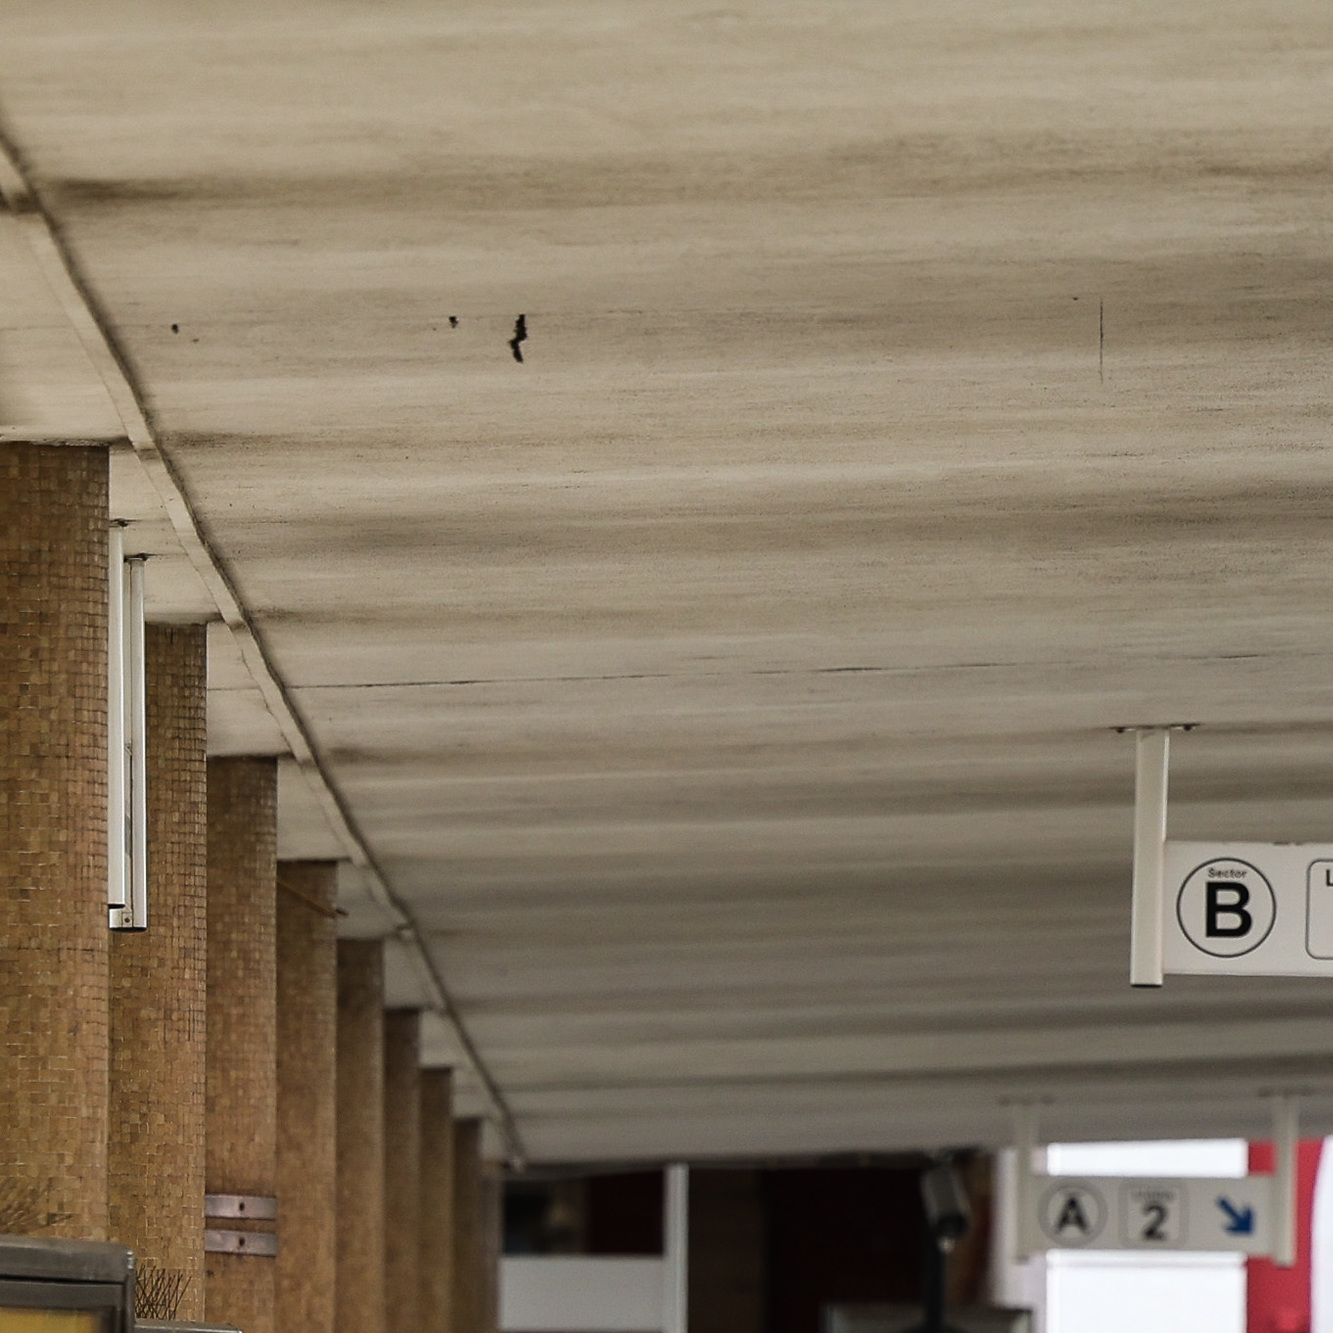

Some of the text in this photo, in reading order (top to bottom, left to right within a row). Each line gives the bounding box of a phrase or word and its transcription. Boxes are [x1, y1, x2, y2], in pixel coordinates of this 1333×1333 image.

[1207, 867, 1248, 880] Sector
[1205, 881, 1253, 939] B
[1056, 1194, 1090, 1235] A
[1143, 1203, 1168, 1242] 2
